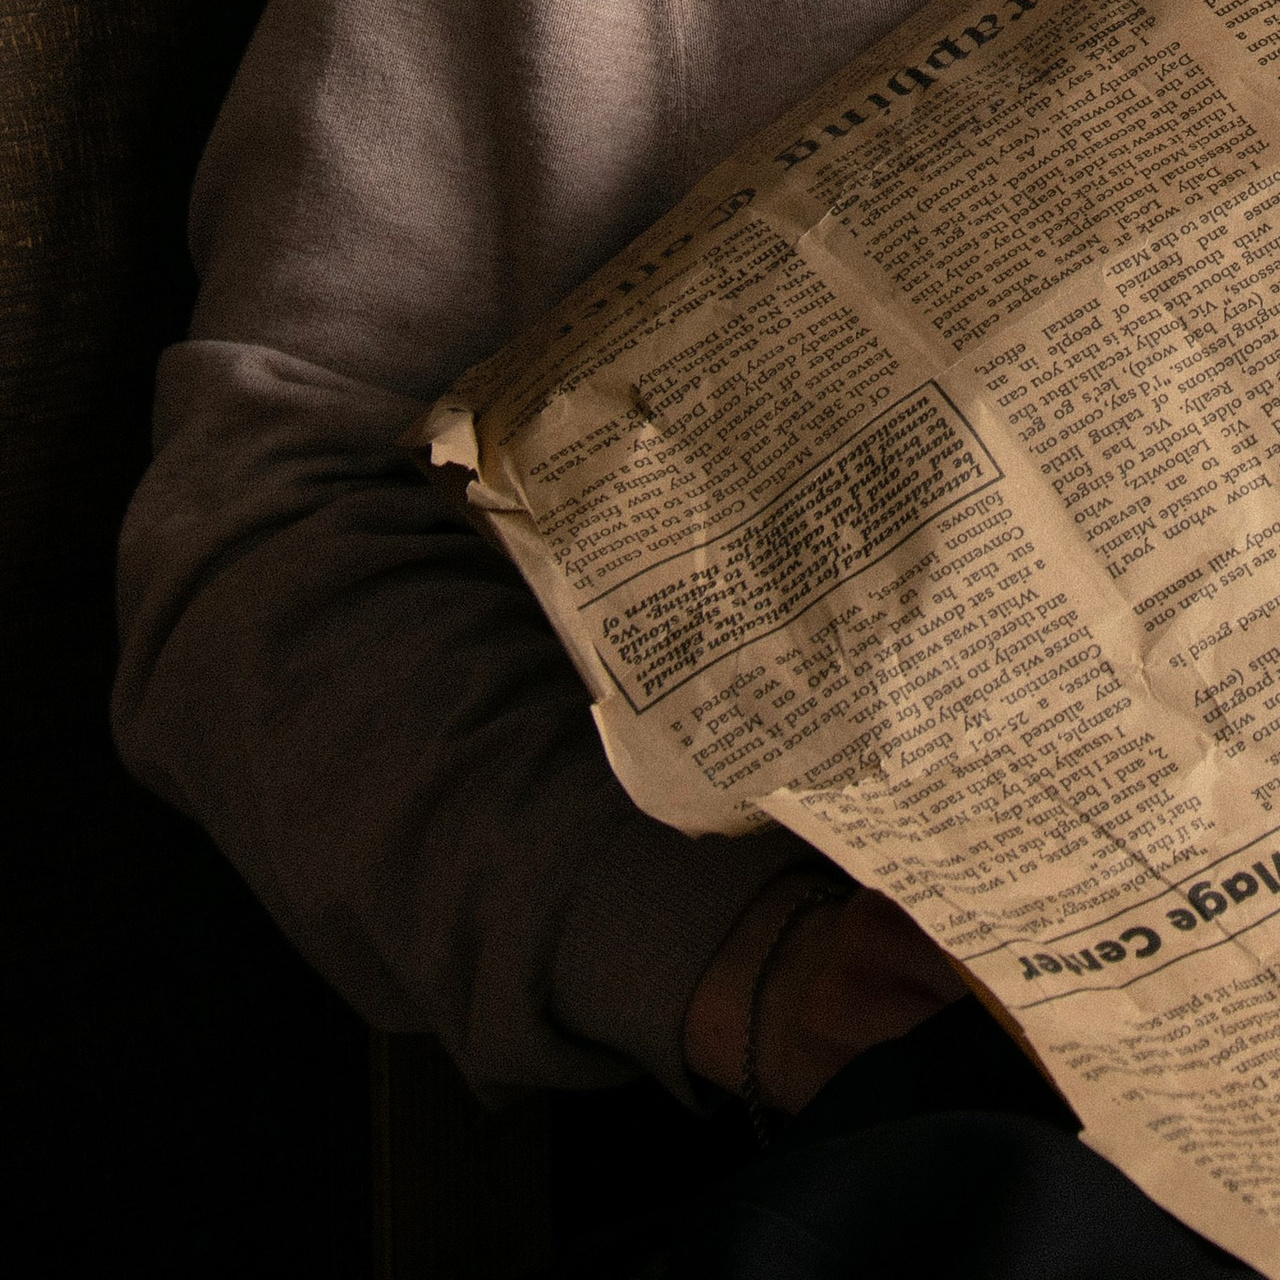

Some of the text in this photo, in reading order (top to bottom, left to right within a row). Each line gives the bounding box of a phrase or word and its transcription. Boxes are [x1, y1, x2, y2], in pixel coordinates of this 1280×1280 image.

[1227, 473, 1272, 504] know
[1162, 505, 1217, 539] whom
[867, 549, 940, 604] interest,
[1105, 536, 1155, 579] you'll
[807, 604, 862, 646] which
[774, 642, 804, 665] we
[689, 665, 766, 724] explored
[669, 720, 682, 731] a
[1261, 801, 1272, 811] a
[1019, 916, 1164, 984] Center
